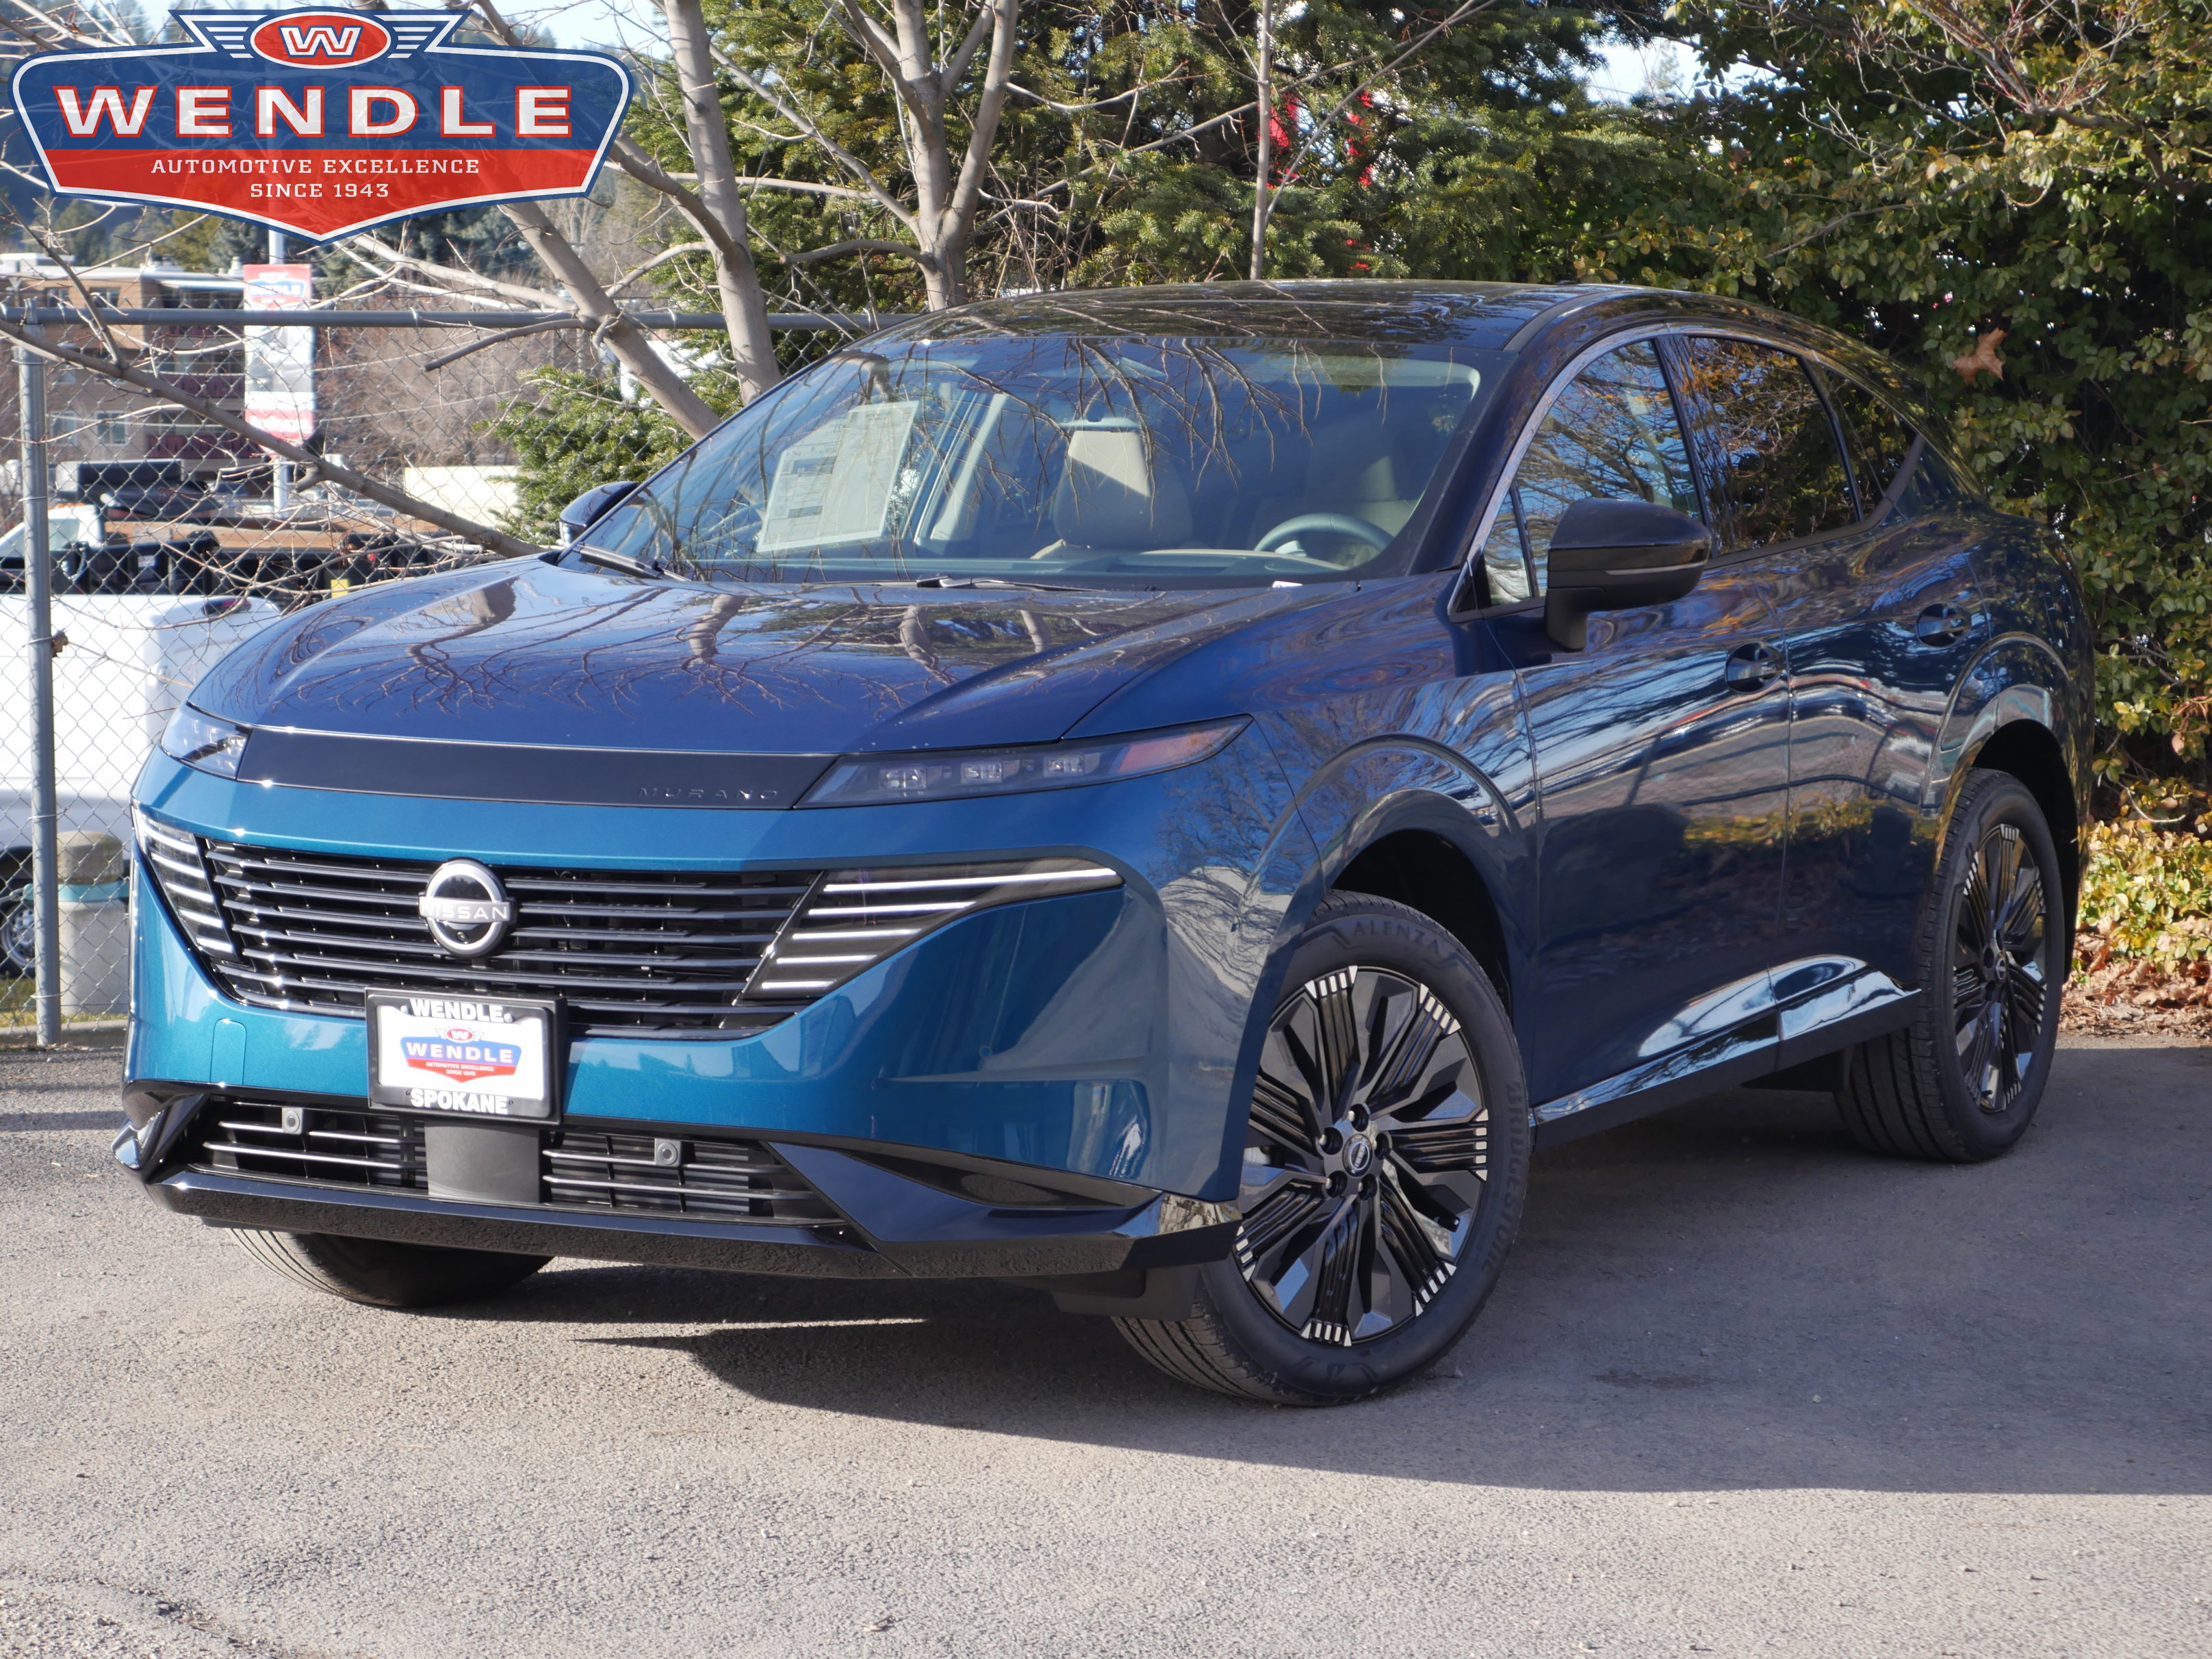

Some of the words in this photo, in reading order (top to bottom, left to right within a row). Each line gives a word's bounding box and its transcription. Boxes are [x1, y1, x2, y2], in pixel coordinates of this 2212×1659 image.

[639, 788, 777, 799] MURANO
[422, 903, 508, 920] NISSAN
[1354, 920, 1440, 954] ALENZA
[410, 999, 504, 1023] WENDLE
[405, 1042, 513, 1064] WENDLE
[411, 1088, 509, 1115] SPOKANE
